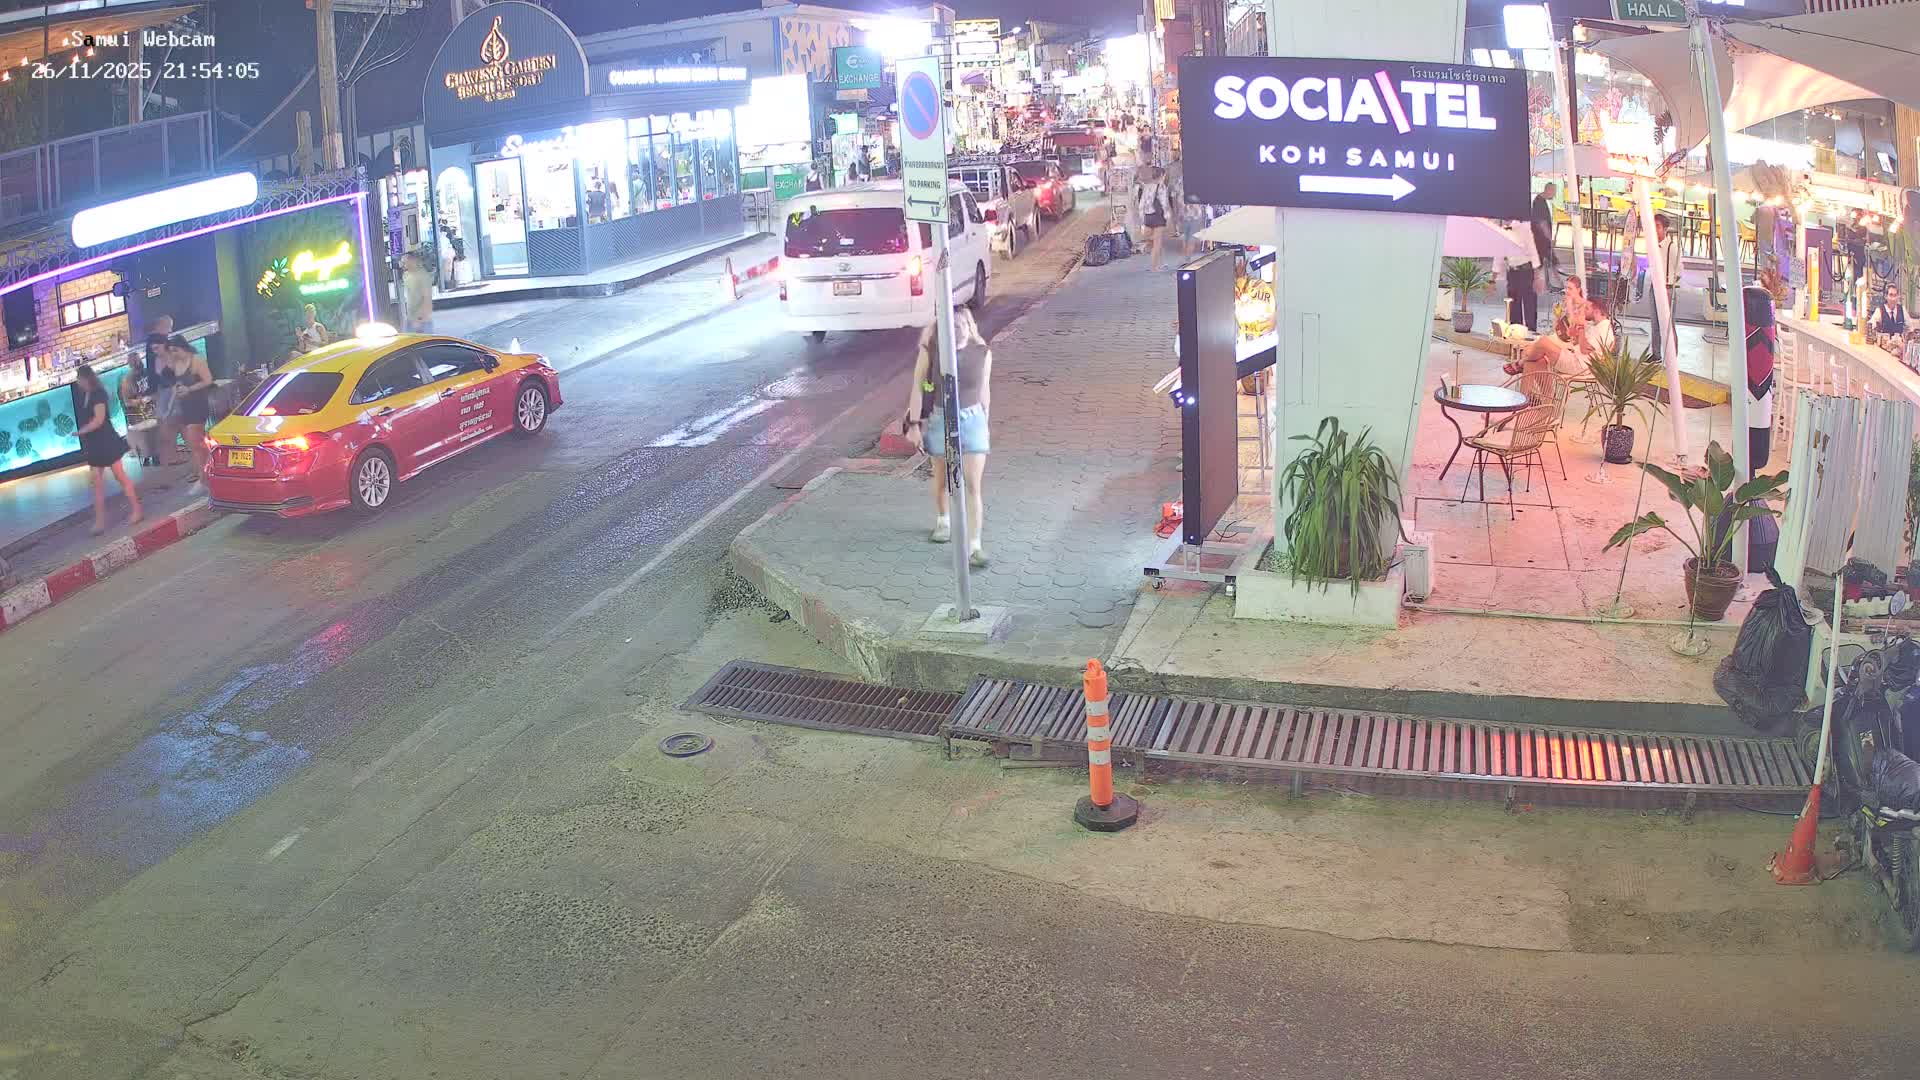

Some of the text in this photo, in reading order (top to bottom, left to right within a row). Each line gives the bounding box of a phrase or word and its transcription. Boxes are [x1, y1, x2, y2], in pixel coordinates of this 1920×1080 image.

[1627, 3, 1677, 17] HALAL
[839, 73, 880, 84] EXCHANGE
[1259, 145, 1455, 171] KOH SAMUI
[909, 179, 941, 189] NO PARKING
